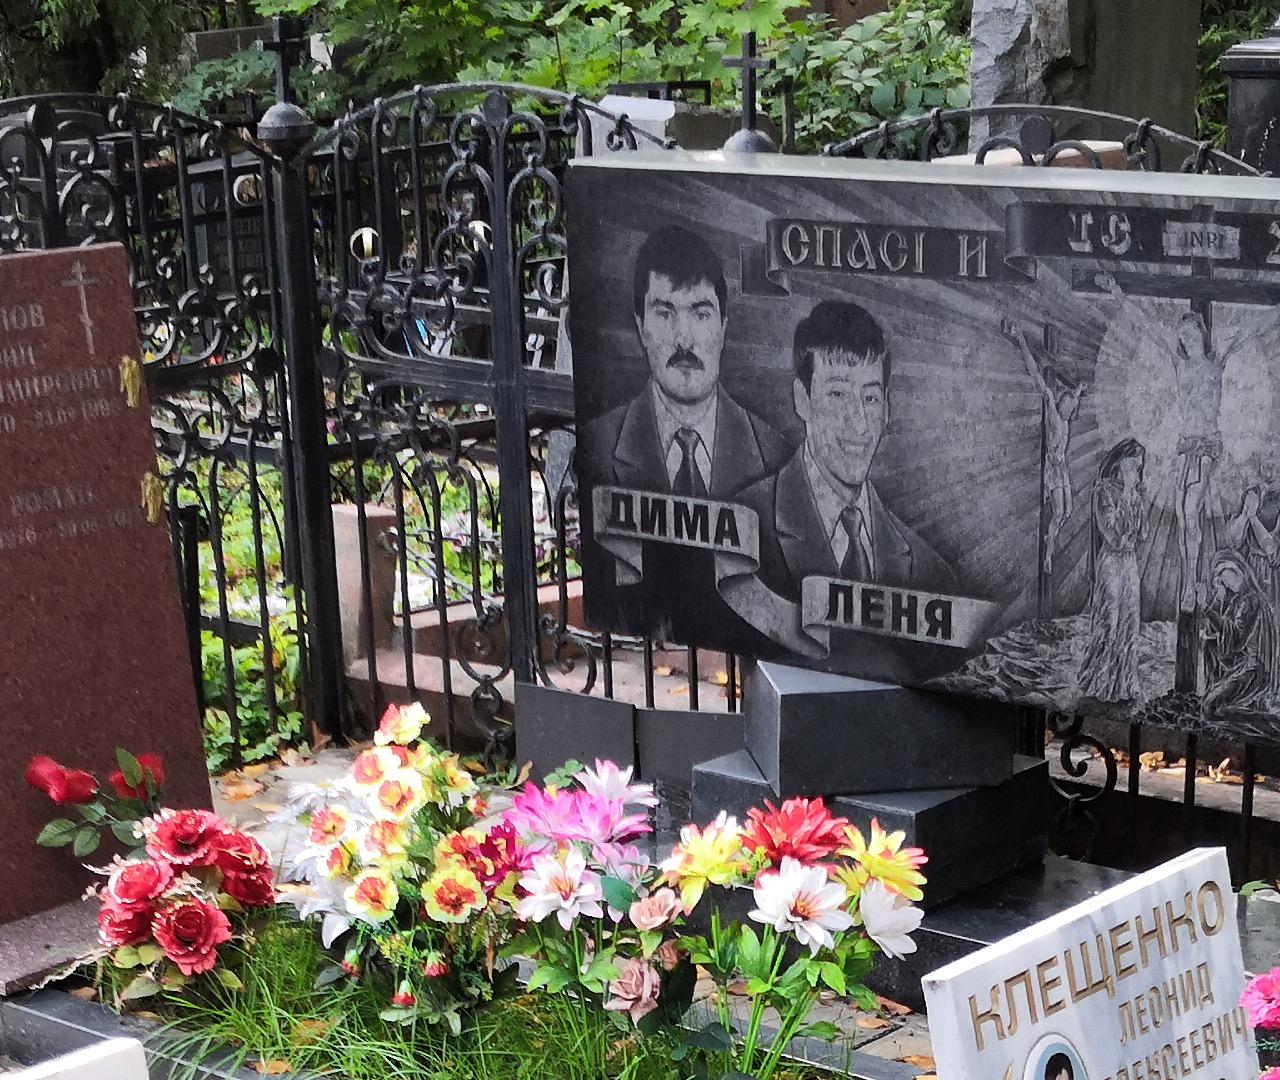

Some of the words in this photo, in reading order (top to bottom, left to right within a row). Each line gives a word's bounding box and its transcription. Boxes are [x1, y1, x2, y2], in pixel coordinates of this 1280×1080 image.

[958, 234, 988, 278] И
[610, 490, 741, 549] ДИМА
[826, 583, 953, 640] ЛЕНЯ
[968, 880, 1226, 1052] КЛЕЩЕНКО
[1118, 960, 1215, 1047] ЛЕОНИД
